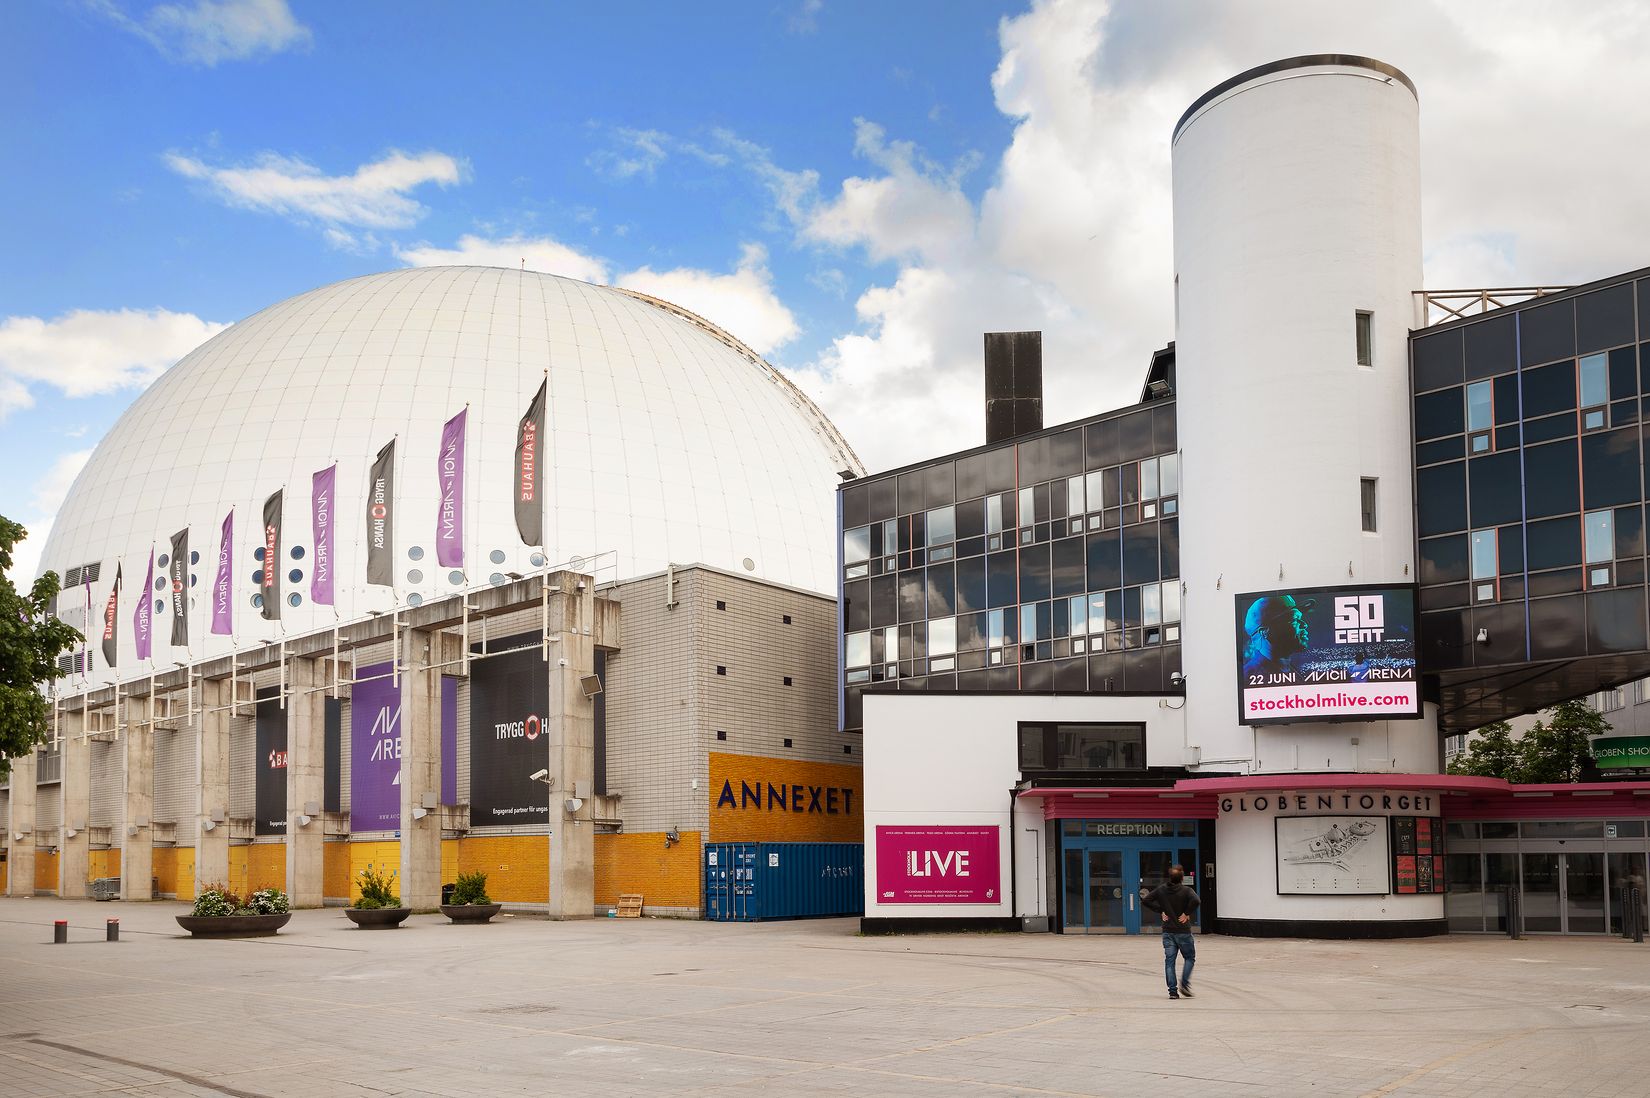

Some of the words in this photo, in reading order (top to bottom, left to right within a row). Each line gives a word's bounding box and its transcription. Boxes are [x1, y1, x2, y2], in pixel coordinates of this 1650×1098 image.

[1334, 595, 1385, 629] 50
[1335, 628, 1385, 644] CENT
[1249, 674, 1264, 685] 22
[1267, 672, 1296, 685] JUNI
[1304, 669, 1347, 682] AVICII
[1361, 667, 1412, 680] ARENA
[1250, 692, 1409, 711] stockholmlive.com
[495, 720, 524, 740] TRYGG
[1595, 747, 1625, 758] GLOBEN
[1627, 746, 1650, 756] SHO
[717, 778, 853, 815] ANNEXET
[1221, 794, 1432, 813] GLOBENTORGET
[1097, 824, 1163, 835] RECEPTION
[911, 850, 969, 877] LIVE
